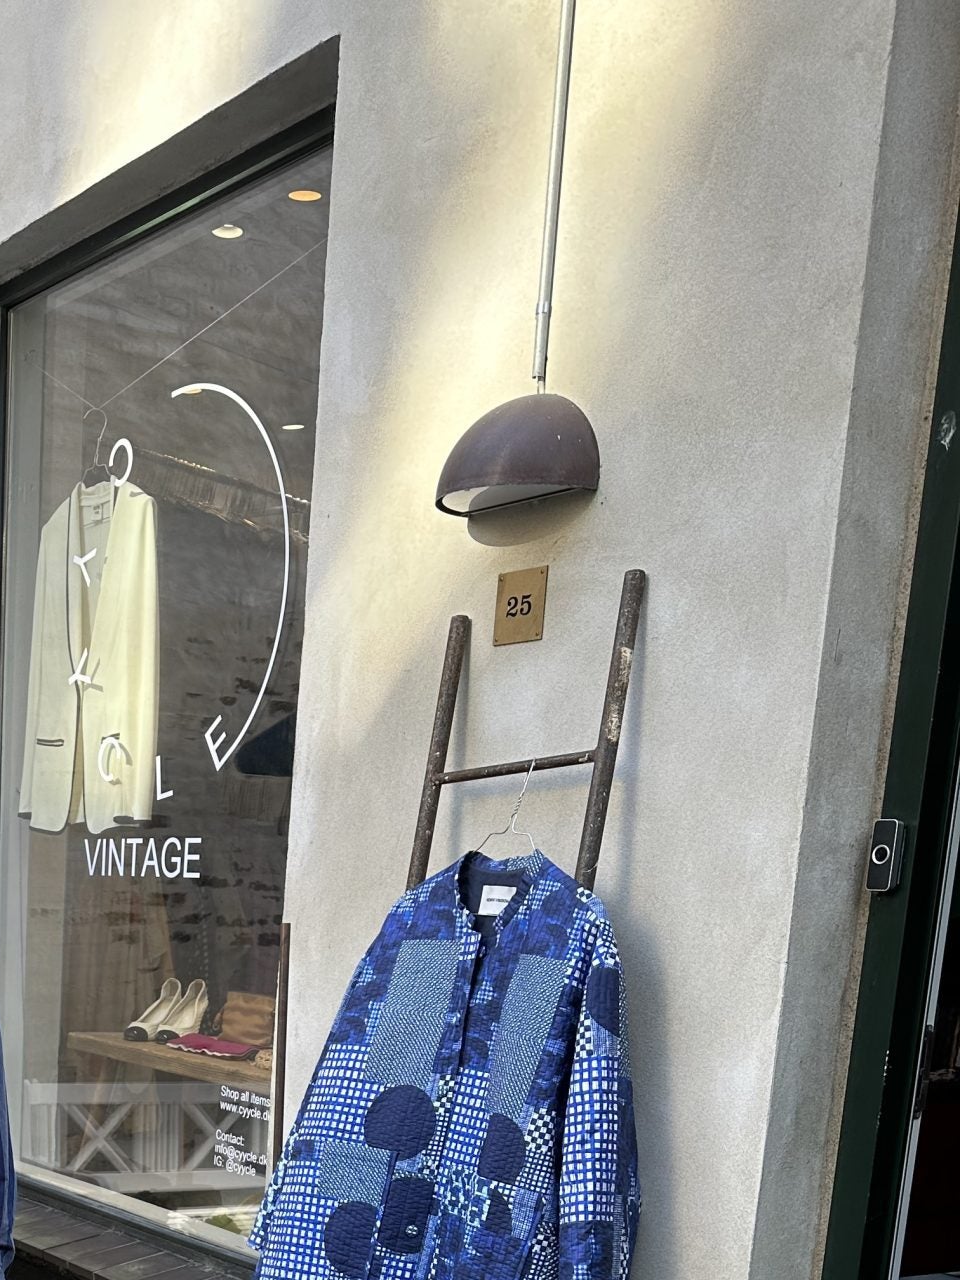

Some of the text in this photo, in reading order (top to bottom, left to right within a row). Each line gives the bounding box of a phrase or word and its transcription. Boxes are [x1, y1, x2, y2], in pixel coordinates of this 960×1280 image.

[506, 594, 532, 618] 25
[84, 837, 202, 879] VINTAGE
[220, 1085, 271, 1107] Shop all items
[213, 1154, 256, 1177] IG: @cyycle
